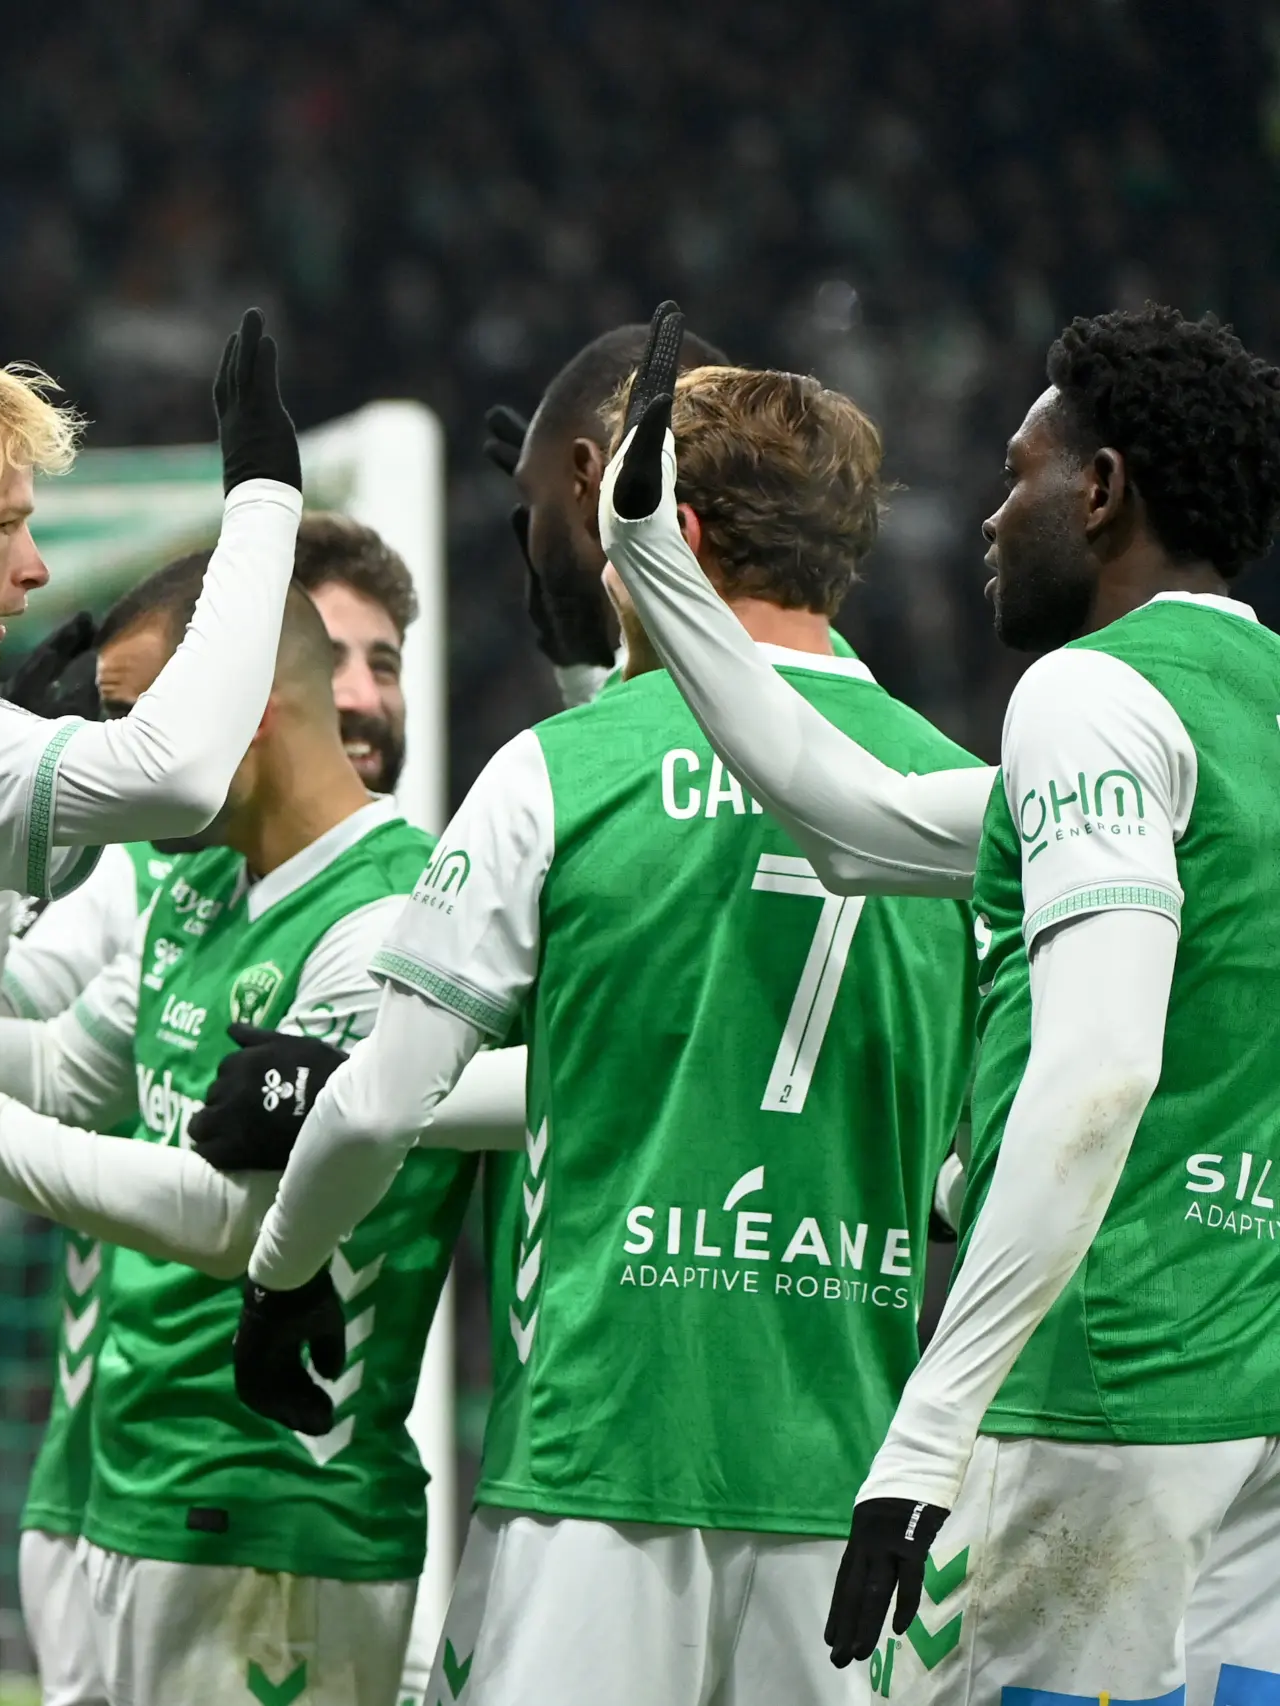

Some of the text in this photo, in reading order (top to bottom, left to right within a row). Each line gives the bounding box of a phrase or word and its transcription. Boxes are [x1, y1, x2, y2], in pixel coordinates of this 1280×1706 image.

[661, 748, 763, 820] CA
[410, 891, 455, 915] ERGIE
[751, 853, 867, 1114] 7
[1184, 1151, 1275, 1209] SIL
[620, 1264, 909, 1310] ADAPTIVE ROBOTICS
